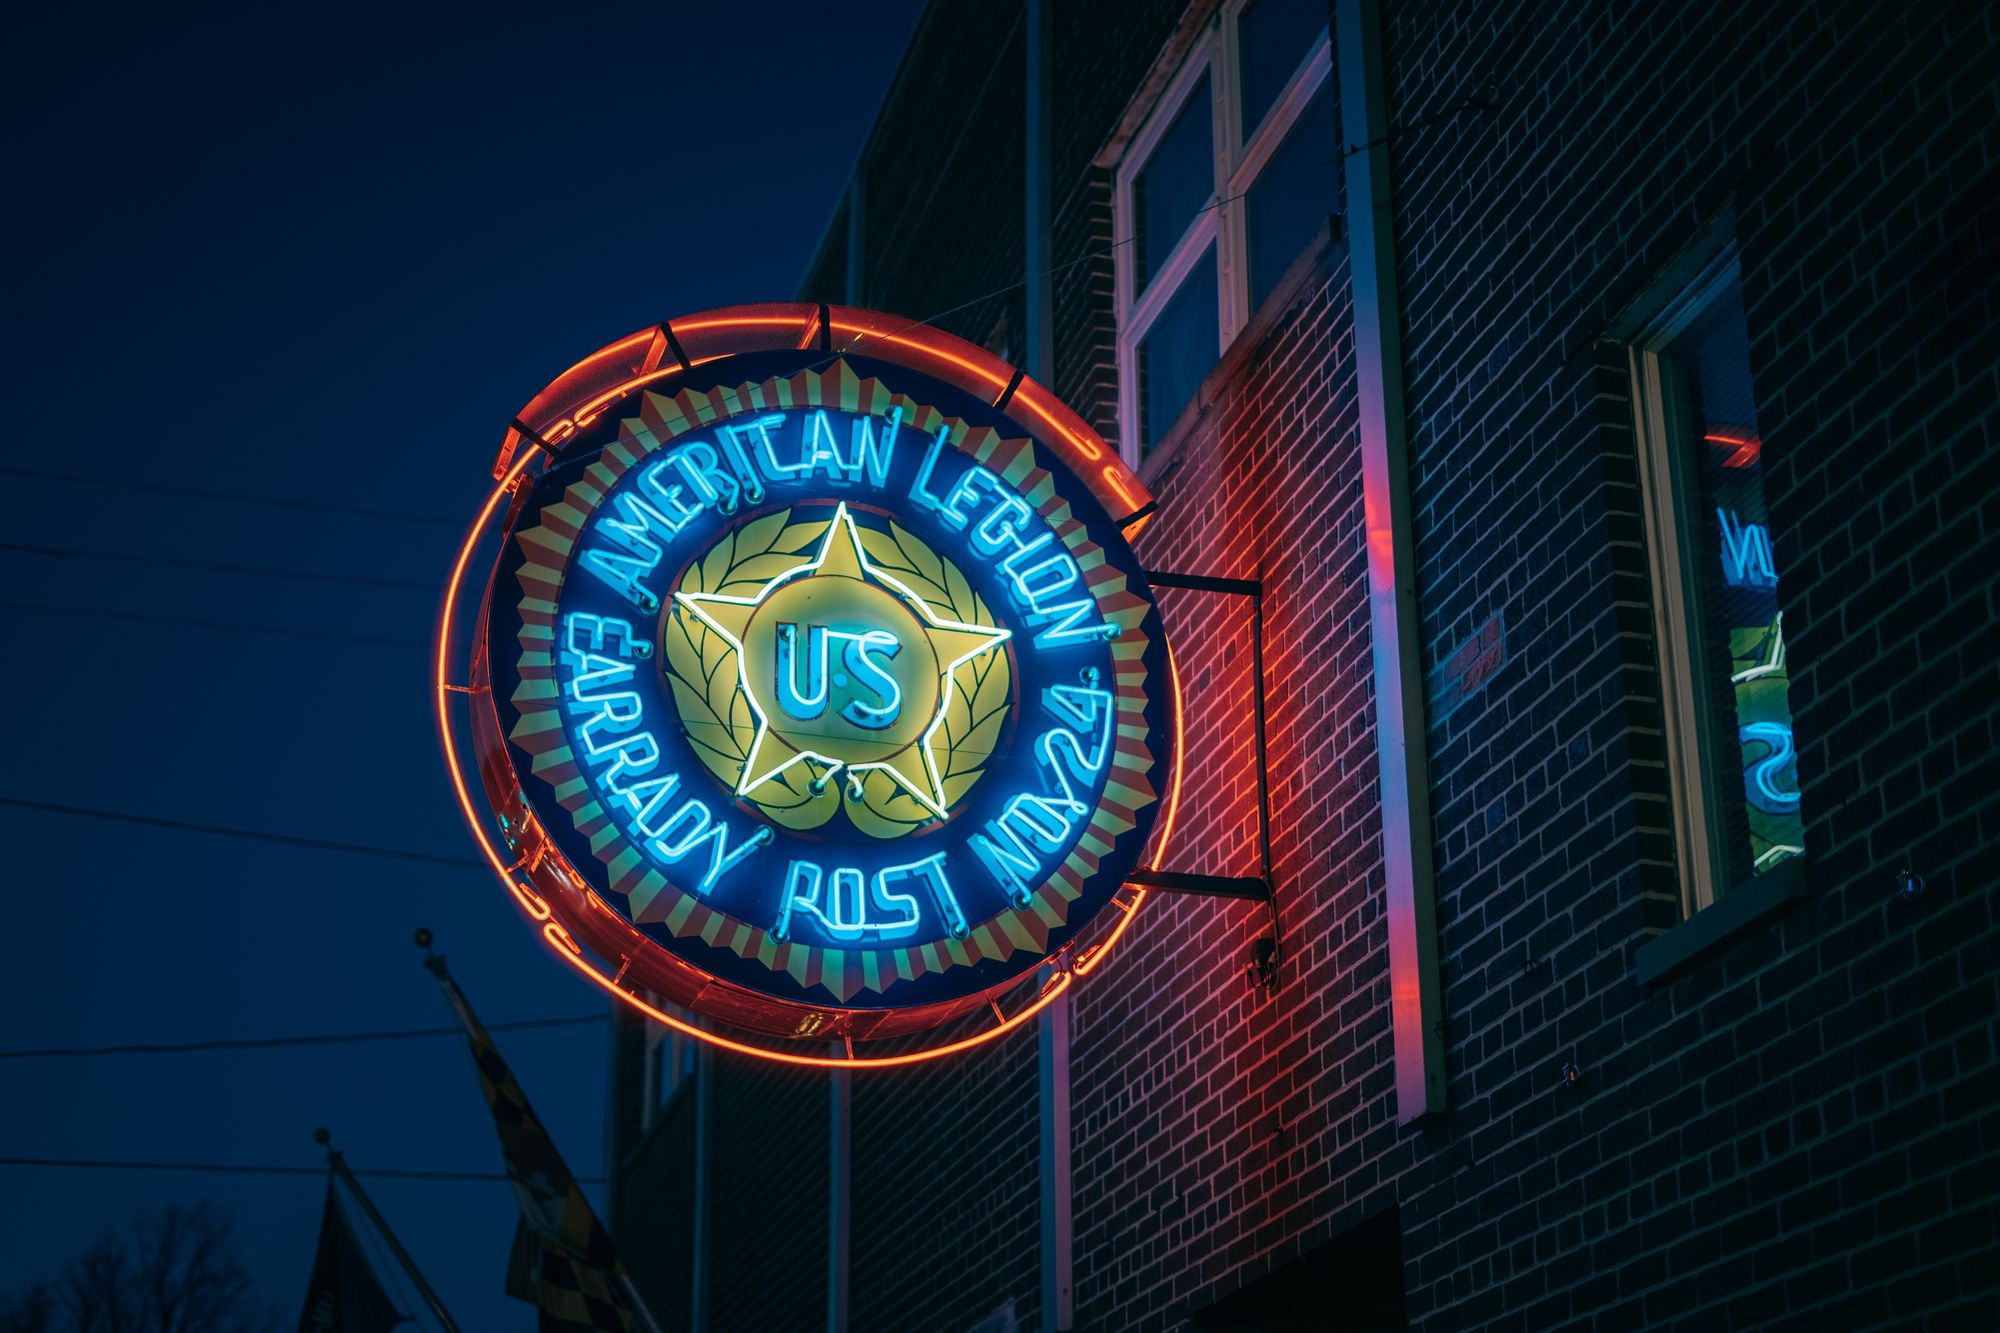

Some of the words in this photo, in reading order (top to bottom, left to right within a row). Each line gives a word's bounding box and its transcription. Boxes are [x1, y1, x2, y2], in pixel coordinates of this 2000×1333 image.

[578, 407, 904, 606] AMERICAN
[909, 425, 1118, 650] LEGION
[772, 852, 966, 940] POST
